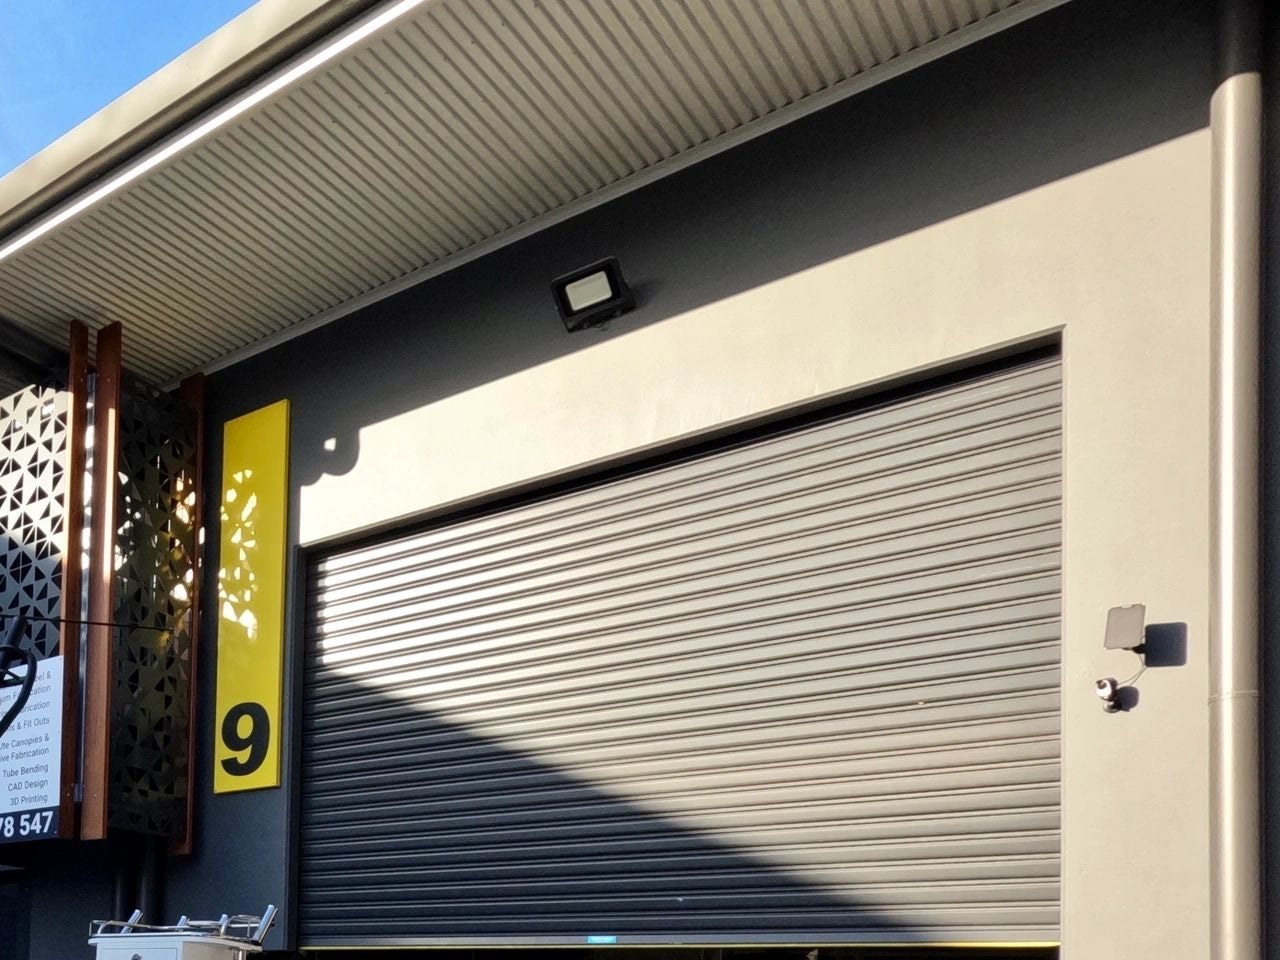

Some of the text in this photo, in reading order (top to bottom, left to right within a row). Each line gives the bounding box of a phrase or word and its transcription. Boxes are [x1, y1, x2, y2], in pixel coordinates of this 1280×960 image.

[46, 670, 52, 679] &
[16, 721, 22, 731] &
[23, 719, 32, 729] Fit
[33, 716, 51, 727] Outs
[10, 735, 43, 749] Canopies
[44, 733, 50, 743] &
[220, 701, 271, 777] 9
[11, 746, 50, 760] Fabrication
[2, 763, 49, 778] Tube Bending
[7, 778, 49, 792] CAD Design
[9, 793, 48, 807] 3D Printing
[19, 811, 54, 836] 547
